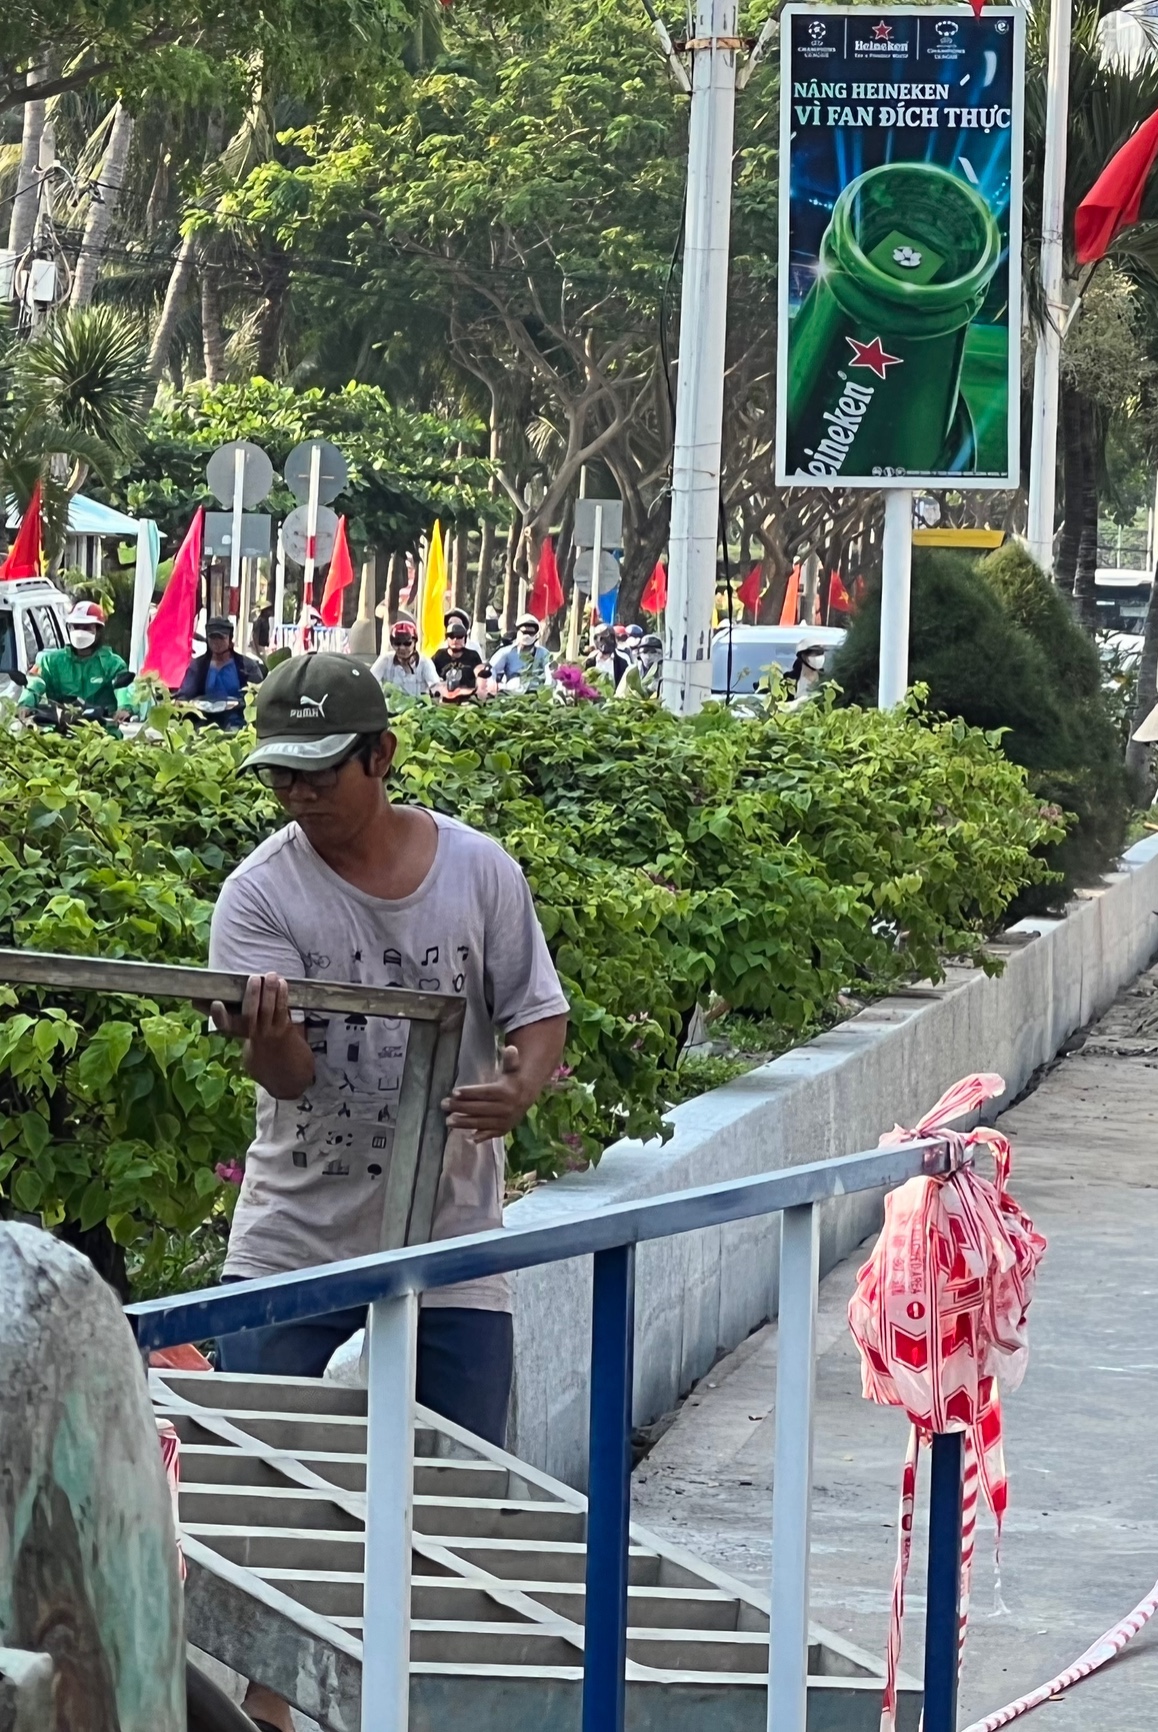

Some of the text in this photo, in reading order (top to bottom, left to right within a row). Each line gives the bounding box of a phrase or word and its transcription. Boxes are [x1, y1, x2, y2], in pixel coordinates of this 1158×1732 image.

[854, 40, 909, 52] Heineken
[793, 78, 950, 100] NÂNG HEINEKEN
[794, 100, 1011, 134] VÌ FAN ĐÍCH THỰC
[290, 707, 319, 719] PUMA
